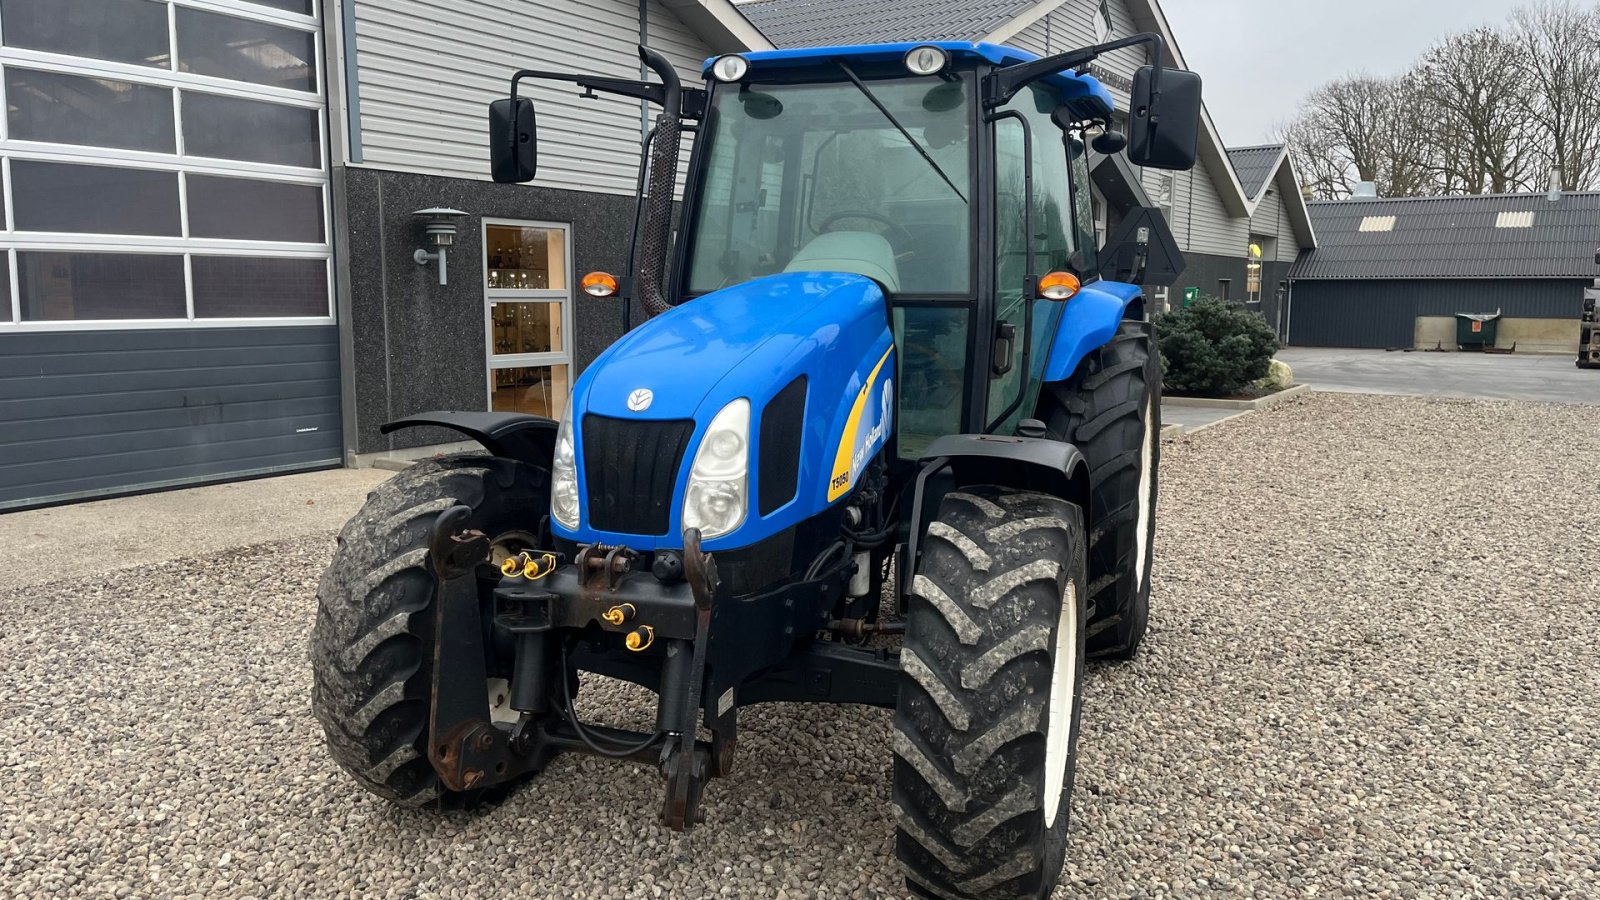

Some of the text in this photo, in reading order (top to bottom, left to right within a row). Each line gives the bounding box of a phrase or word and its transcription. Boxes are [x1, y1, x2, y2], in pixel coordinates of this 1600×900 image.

[852, 417, 882, 474] New Holland
[832, 471, 849, 490] T5050
